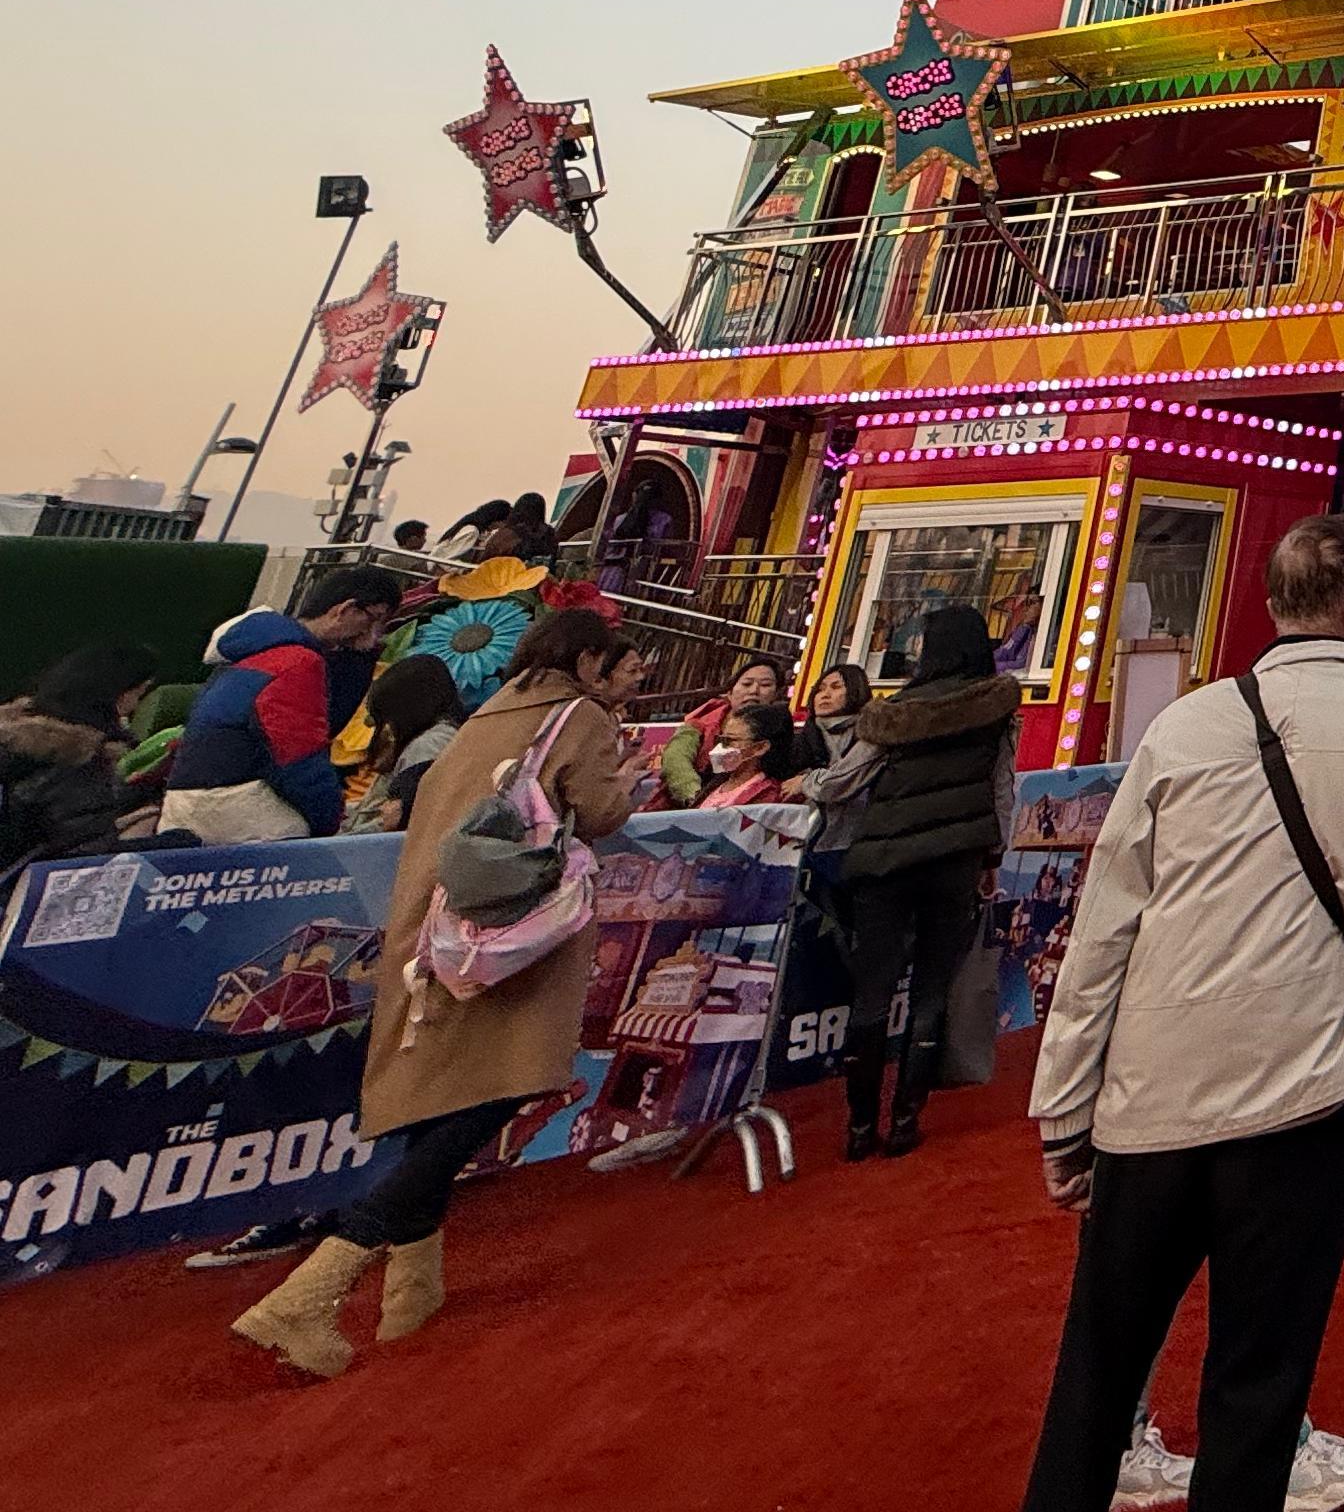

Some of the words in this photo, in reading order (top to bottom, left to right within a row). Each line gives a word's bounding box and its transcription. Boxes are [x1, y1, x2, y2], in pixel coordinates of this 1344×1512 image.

[952, 419, 1028, 444] TICKETS
[150, 872, 214, 893] JOIN
[220, 868, 255, 886] US
[260, 865, 289, 882] IN
[145, 891, 198, 912] THE
[201, 877, 354, 906] METAVERSE
[166, 1120, 219, 1144] THE
